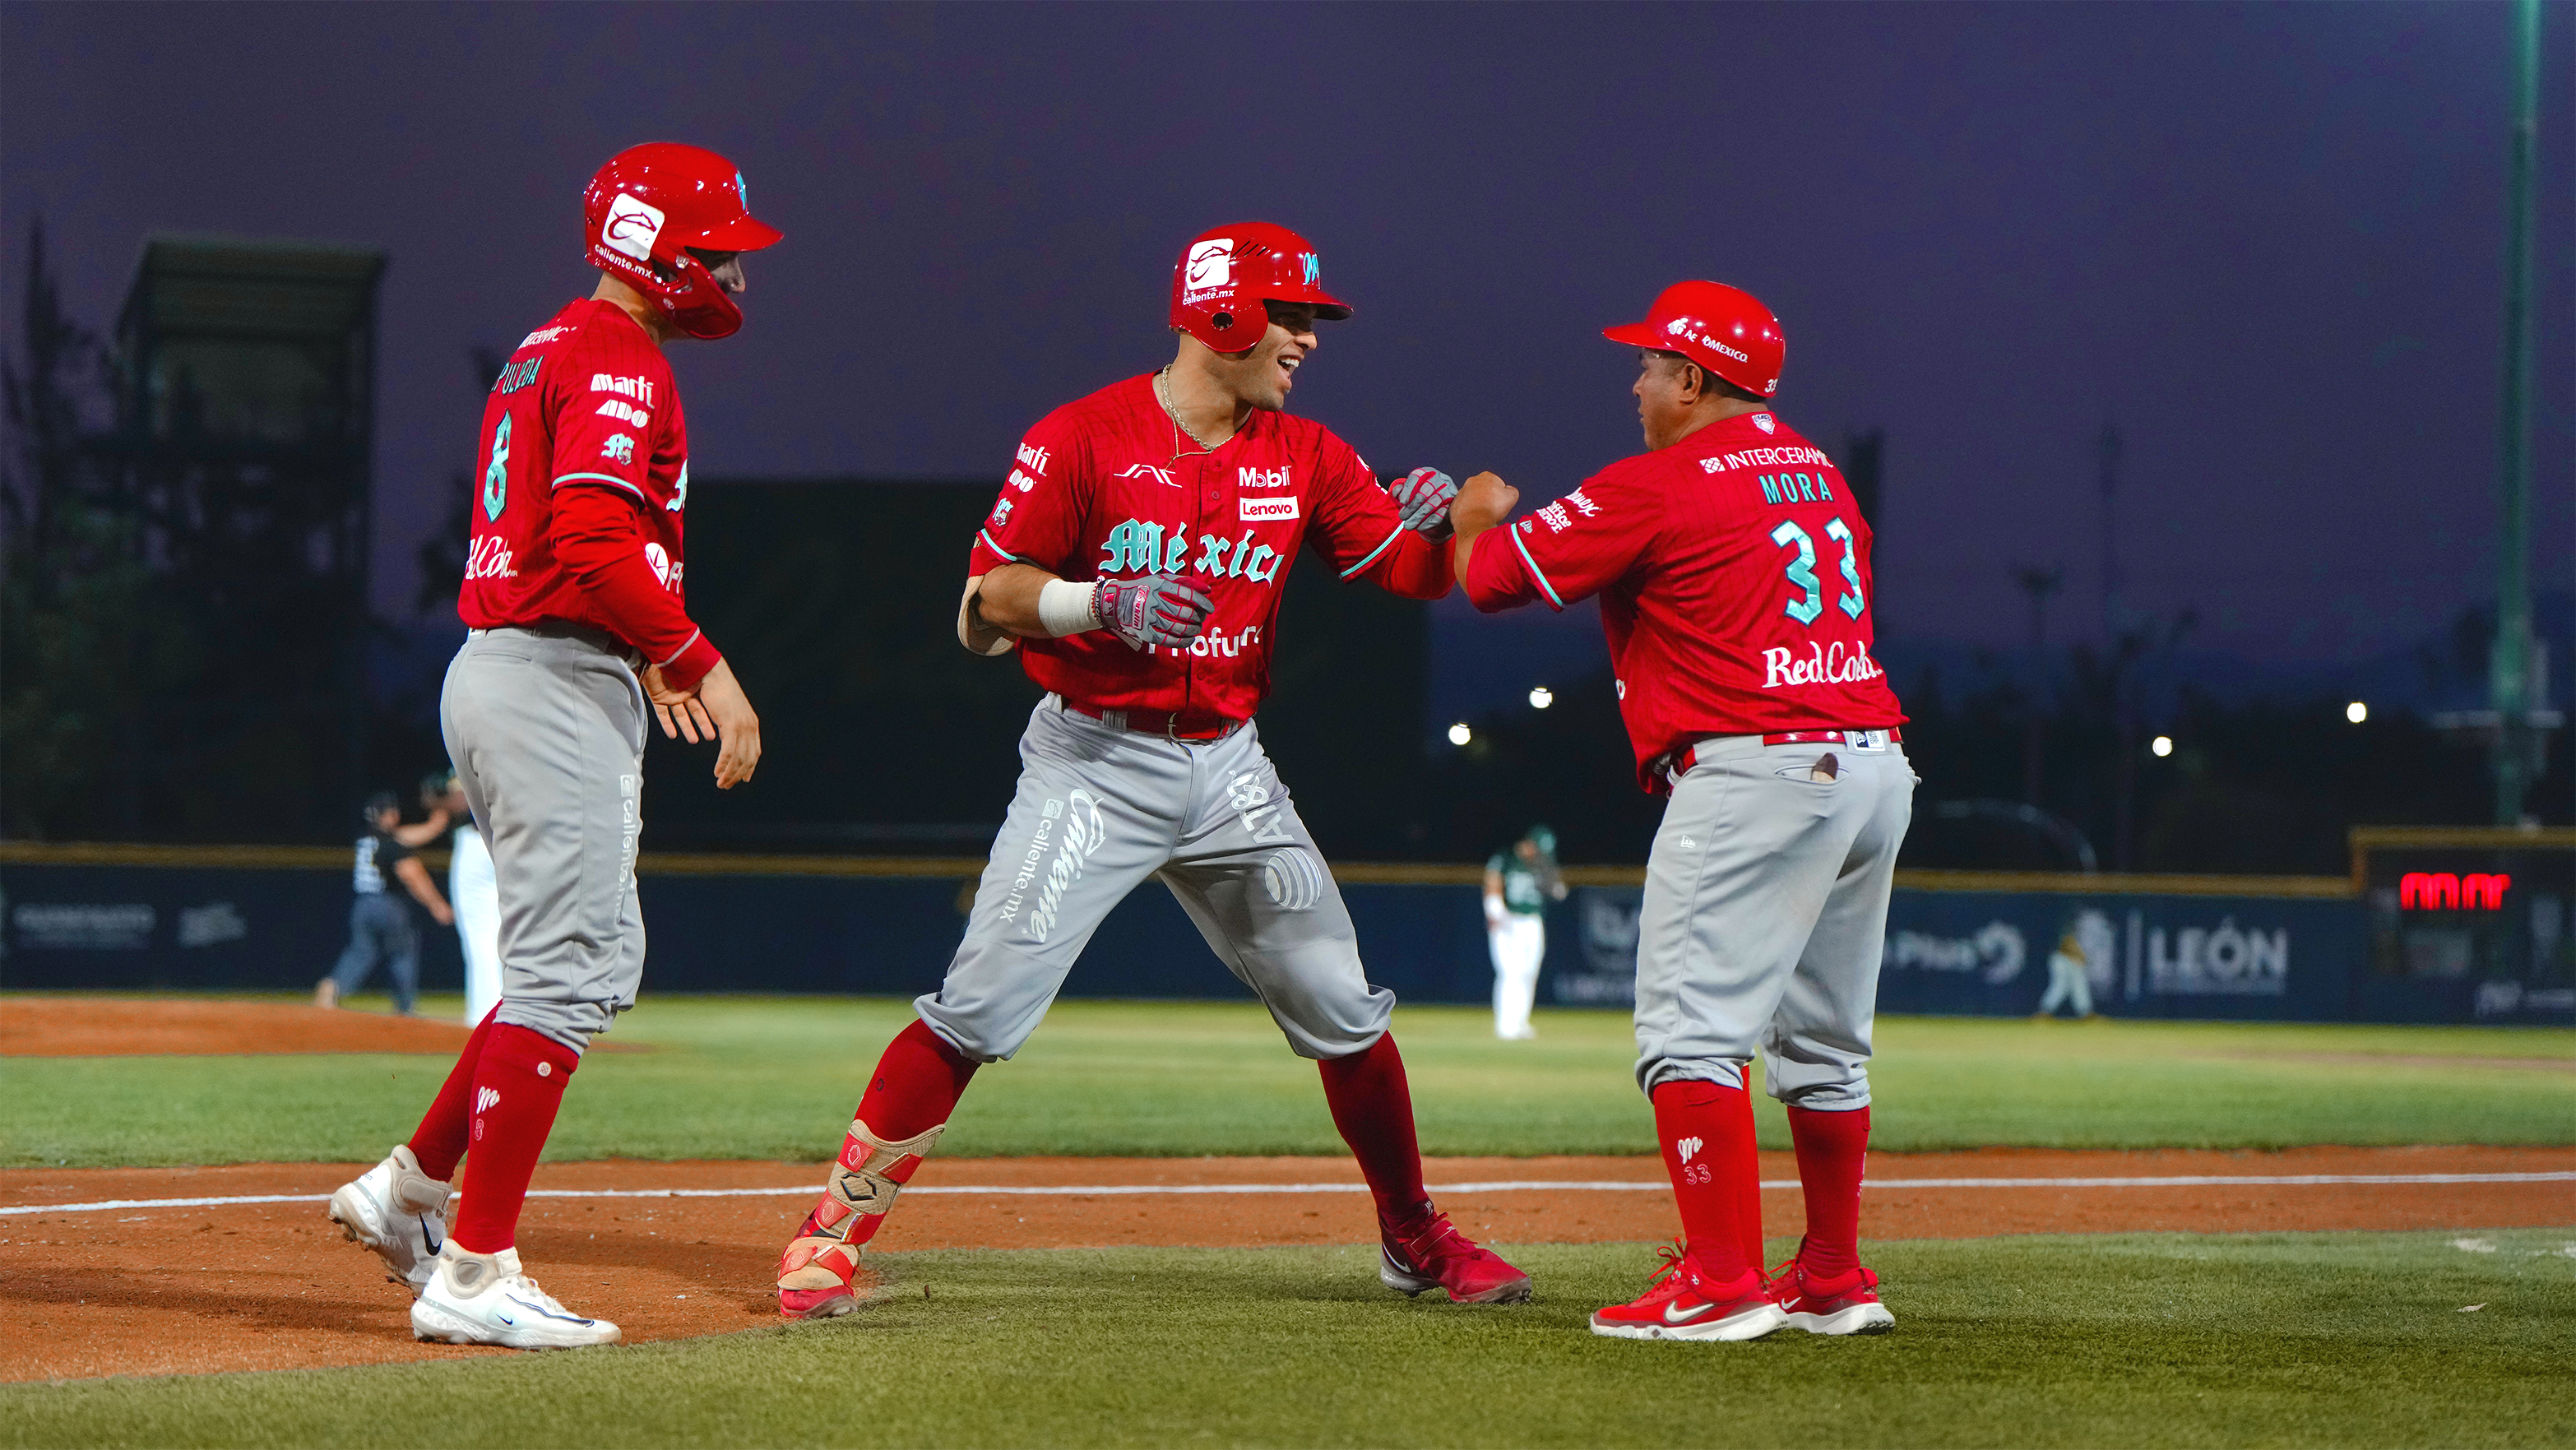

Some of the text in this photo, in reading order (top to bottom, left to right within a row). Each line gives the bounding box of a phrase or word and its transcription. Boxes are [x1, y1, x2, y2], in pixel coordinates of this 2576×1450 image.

[484, 408, 512, 525] 8
[1008, 468, 1037, 493] DO
[1239, 465, 1291, 489] Mobil
[1758, 470, 1835, 505] MORA
[1243, 502, 1293, 517] Lenovo
[1768, 517, 1865, 628] 33
[999, 819, 1053, 924] caliente.mx
[1684, 1164, 1712, 1184] 33
